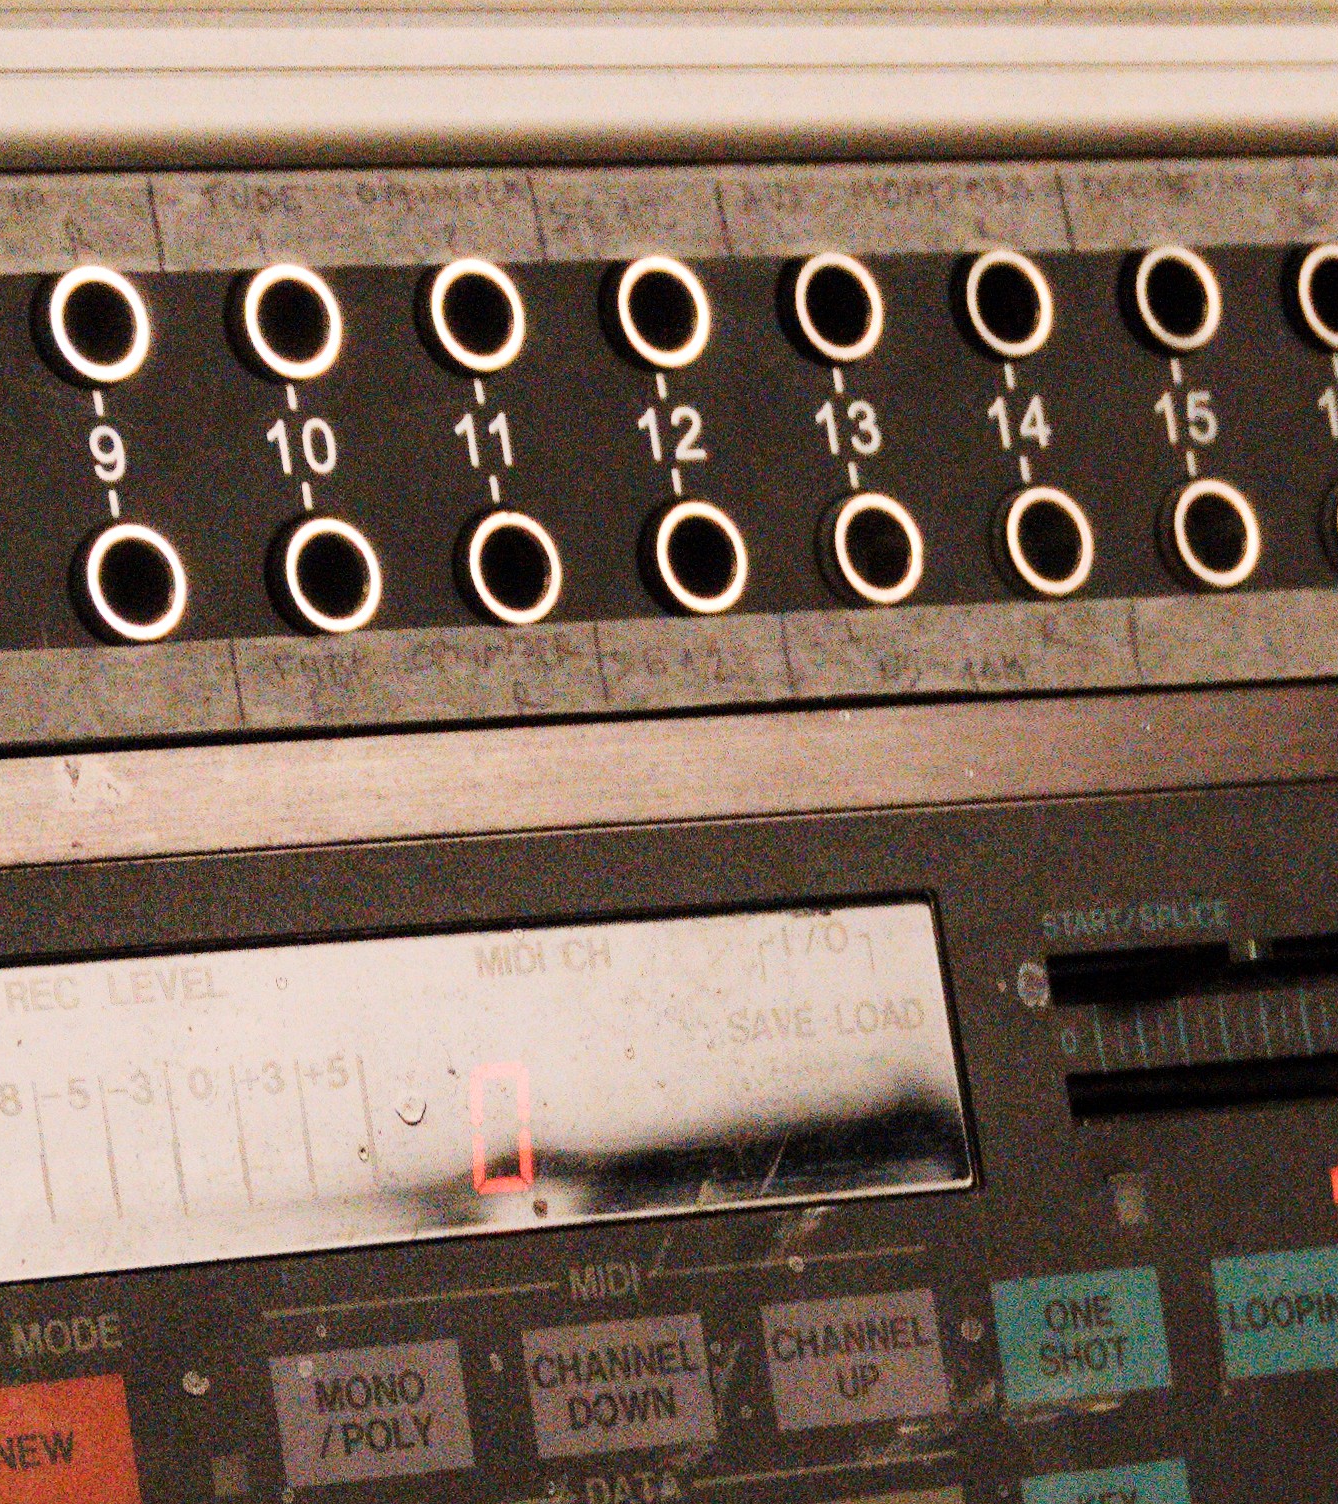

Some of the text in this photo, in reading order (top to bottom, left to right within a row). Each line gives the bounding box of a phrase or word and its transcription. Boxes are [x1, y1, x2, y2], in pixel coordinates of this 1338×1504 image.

[454, 411, 514, 468] 11
[637, 405, 707, 462] 12
[815, 399, 882, 456] 13
[987, 394, 1051, 449] 14
[1154, 390, 1218, 445] 15
[88, 424, 127, 482] 9
[266, 416, 338, 476] 10
[12, 1313, 122, 1356] MODE
[769, 1314, 933, 1363] CHANNEL
[1043, 1295, 1114, 1334] ONE
[530, 1340, 700, 1389] CHANNEL
[1038, 1336, 1128, 1377] SHOT
[314, 1369, 426, 1414] MONO
[836, 1363, 881, 1401] UP
[567, 1386, 677, 1431] DOWN
